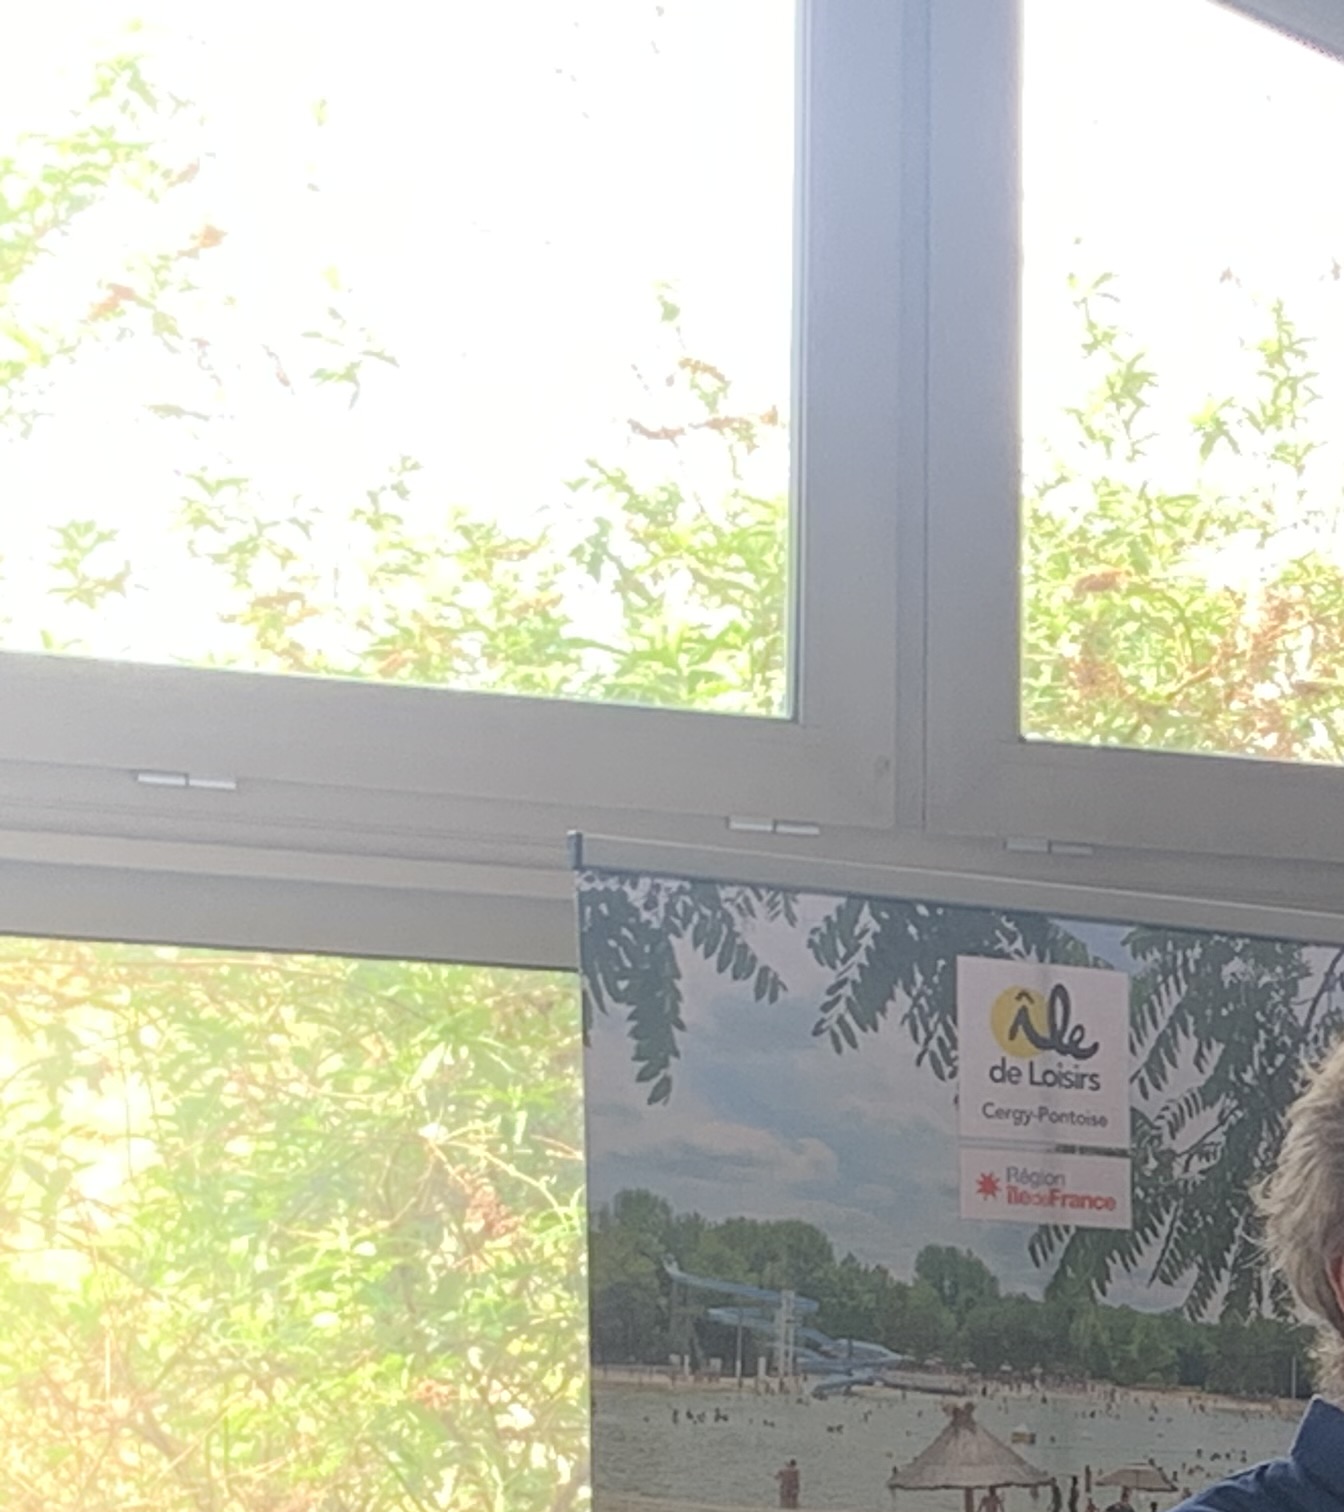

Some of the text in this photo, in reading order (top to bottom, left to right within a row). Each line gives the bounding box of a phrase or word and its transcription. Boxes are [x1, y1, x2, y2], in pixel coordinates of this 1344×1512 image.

[989, 1057, 1101, 1092] de Loisirs
[981, 1102, 1108, 1128] Cergy-Pontoise
[1006, 1166, 1066, 1189] Région
